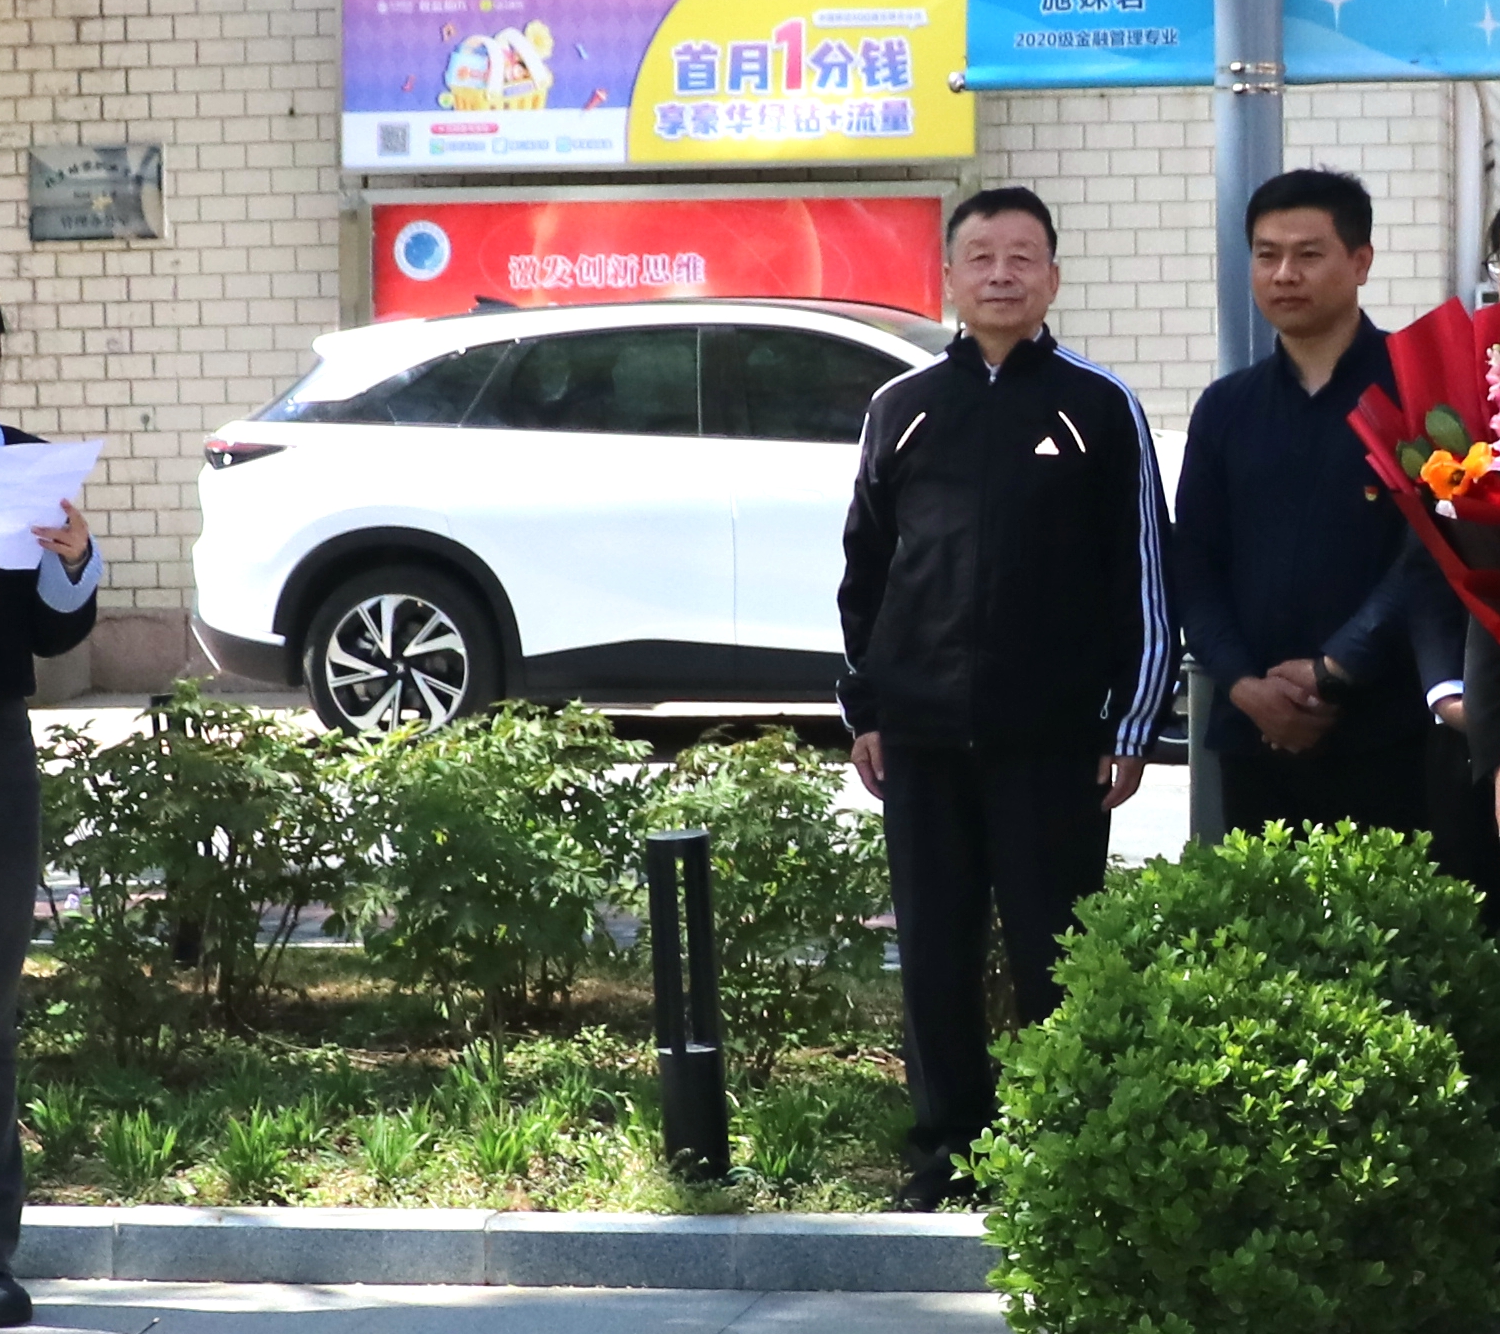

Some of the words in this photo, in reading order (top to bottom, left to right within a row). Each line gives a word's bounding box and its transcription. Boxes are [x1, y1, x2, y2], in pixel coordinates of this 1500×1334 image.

[674, 18, 911, 92] 首月1分钱
[1014, 28, 1180, 49] 2020级金融管理专业
[657, 98, 912, 137] 享豪华绿钻+流量
[508, 253, 706, 288] 激发创新思维
